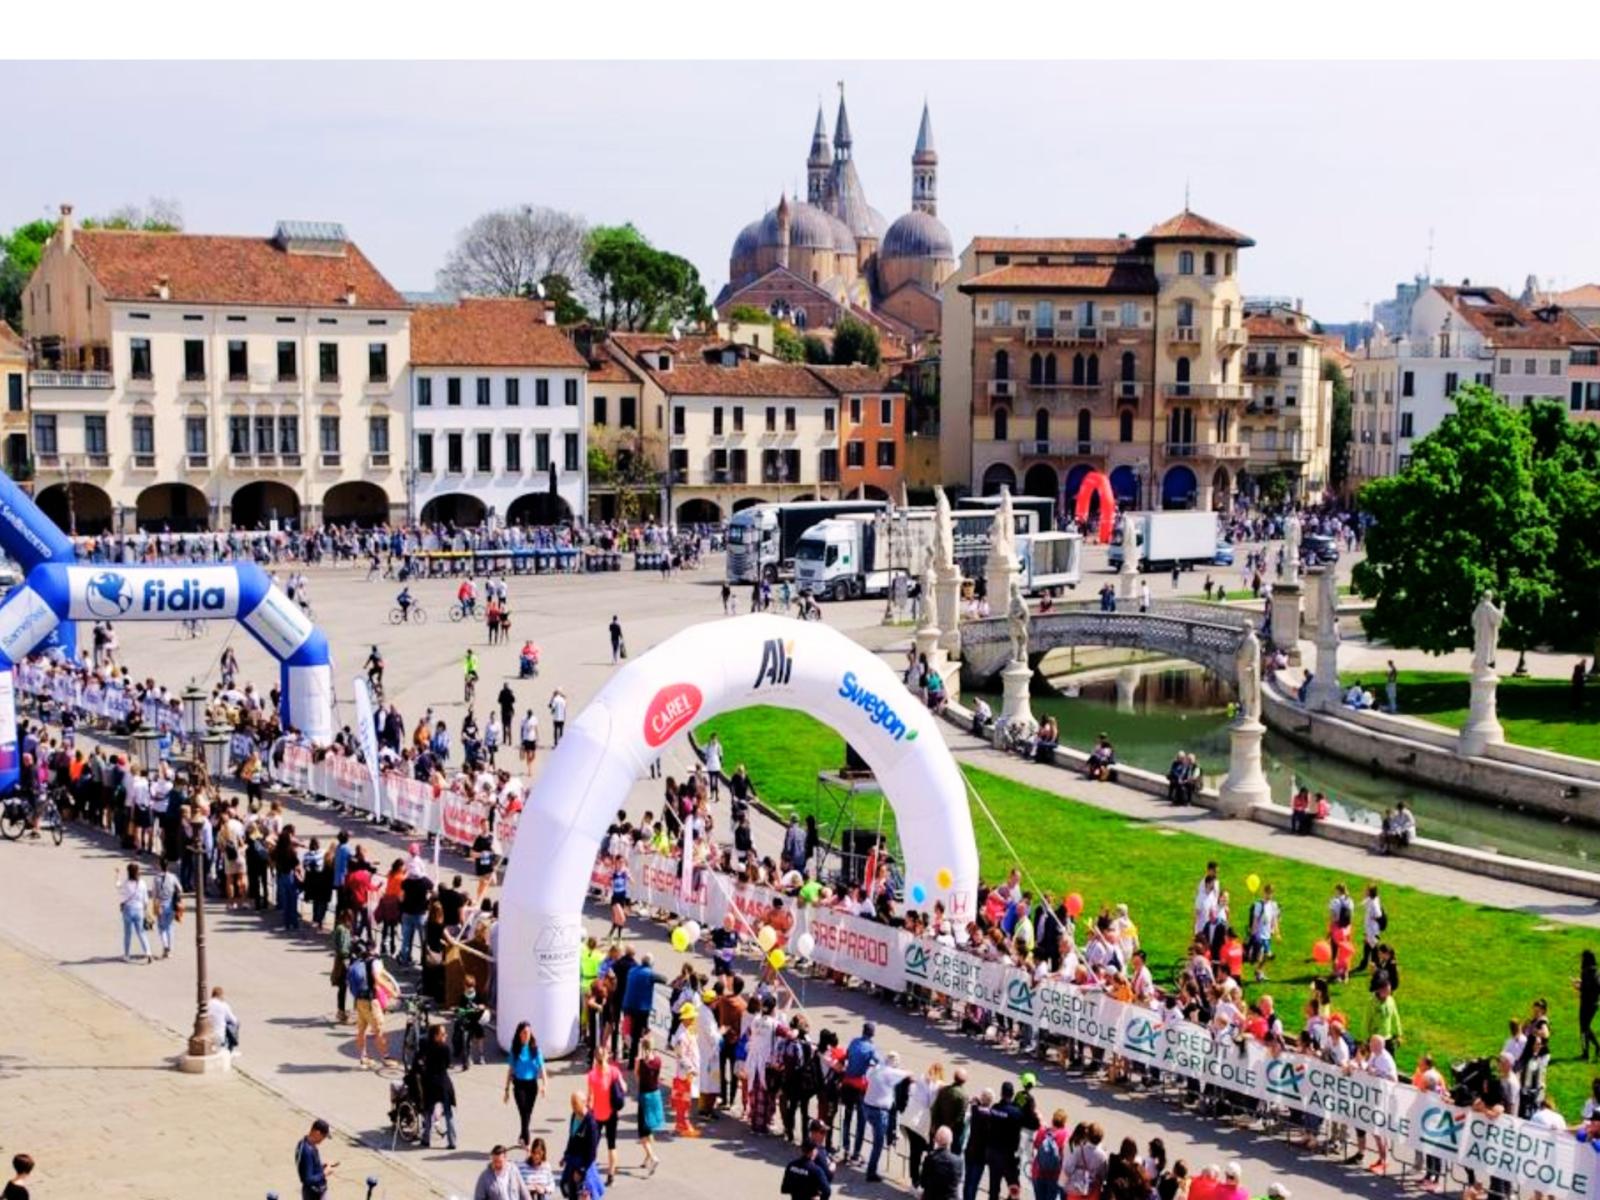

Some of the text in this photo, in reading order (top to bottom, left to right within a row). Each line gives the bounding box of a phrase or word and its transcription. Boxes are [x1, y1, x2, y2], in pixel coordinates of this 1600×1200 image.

[143, 579, 225, 611] fidia
[753, 638, 795, 688] Ali
[652, 694, 692, 733] CAREL
[838, 671, 906, 740] Swegon
[933, 971, 1001, 1005] AGRICOLE
[1040, 1007, 1116, 1043] AGRICOLE
[1163, 1047, 1256, 1088] AGRICOLE
[1309, 1091, 1411, 1137] AGRICOLE
[1467, 1143, 1588, 1195] AGRICOLE
